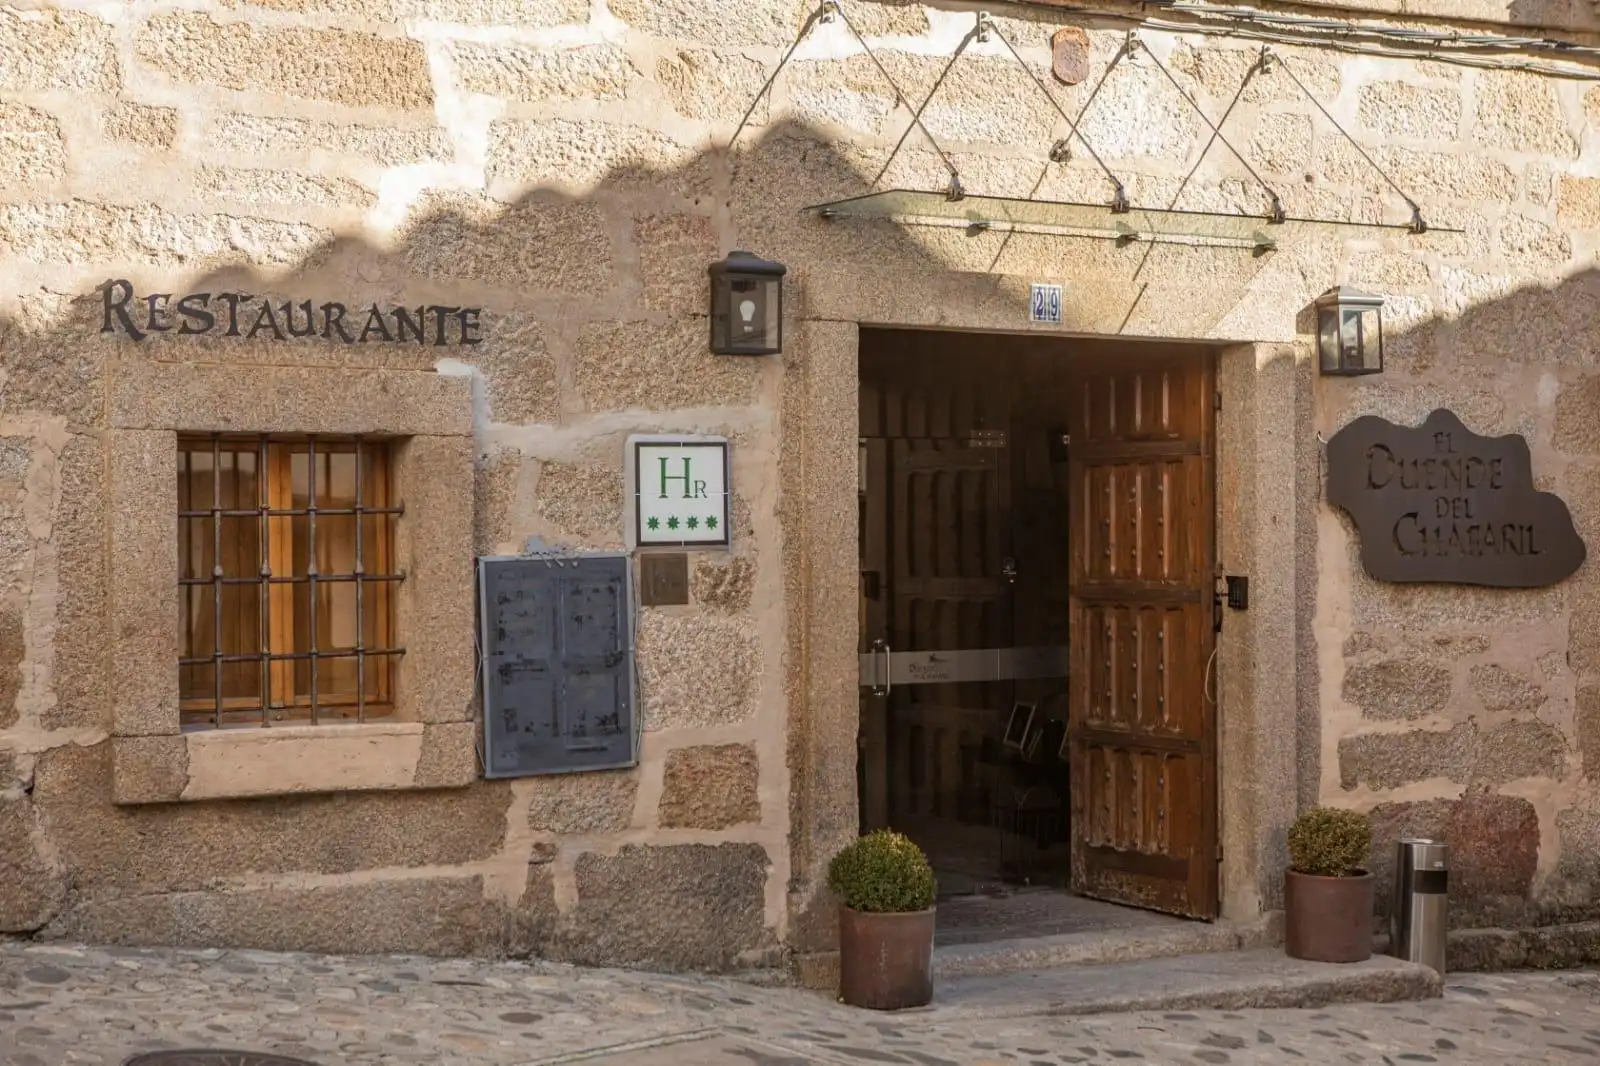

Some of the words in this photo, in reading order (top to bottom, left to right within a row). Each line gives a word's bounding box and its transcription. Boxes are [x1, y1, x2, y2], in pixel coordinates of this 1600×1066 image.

[99, 278, 484, 346] RESTAURANTE
[1035, 289, 1058, 317] 29
[1432, 431, 1458, 453] EL
[1364, 443, 1503, 490] DUENDE
[1435, 497, 1475, 518] DEL
